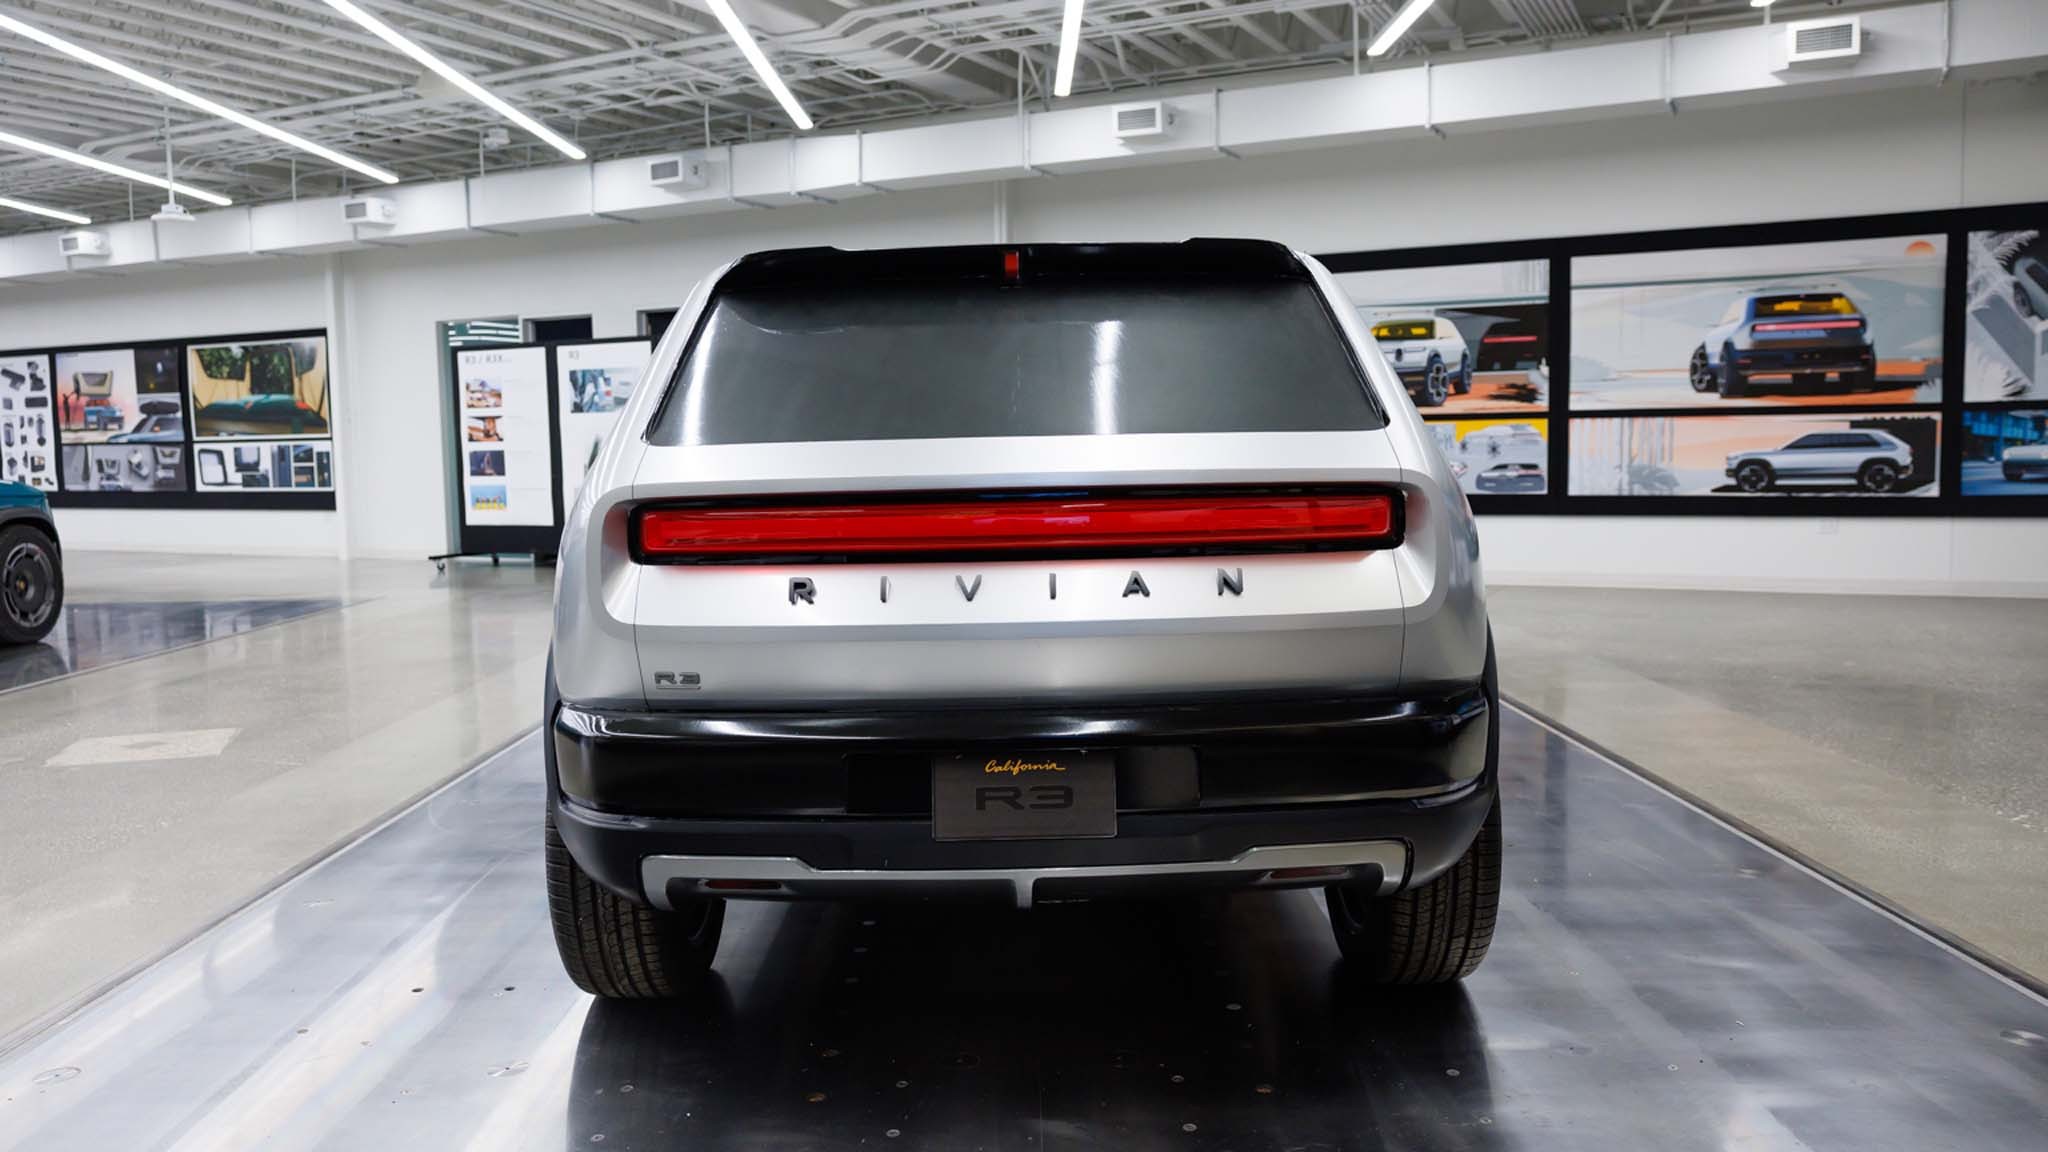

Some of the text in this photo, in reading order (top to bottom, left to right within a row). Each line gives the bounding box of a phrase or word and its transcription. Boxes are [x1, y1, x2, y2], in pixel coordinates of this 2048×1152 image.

[788, 567, 1244, 606] RIVIAN
[654, 671, 701, 686] R3
[985, 760, 1067, 776] California
[976, 785, 1073, 811] R3
